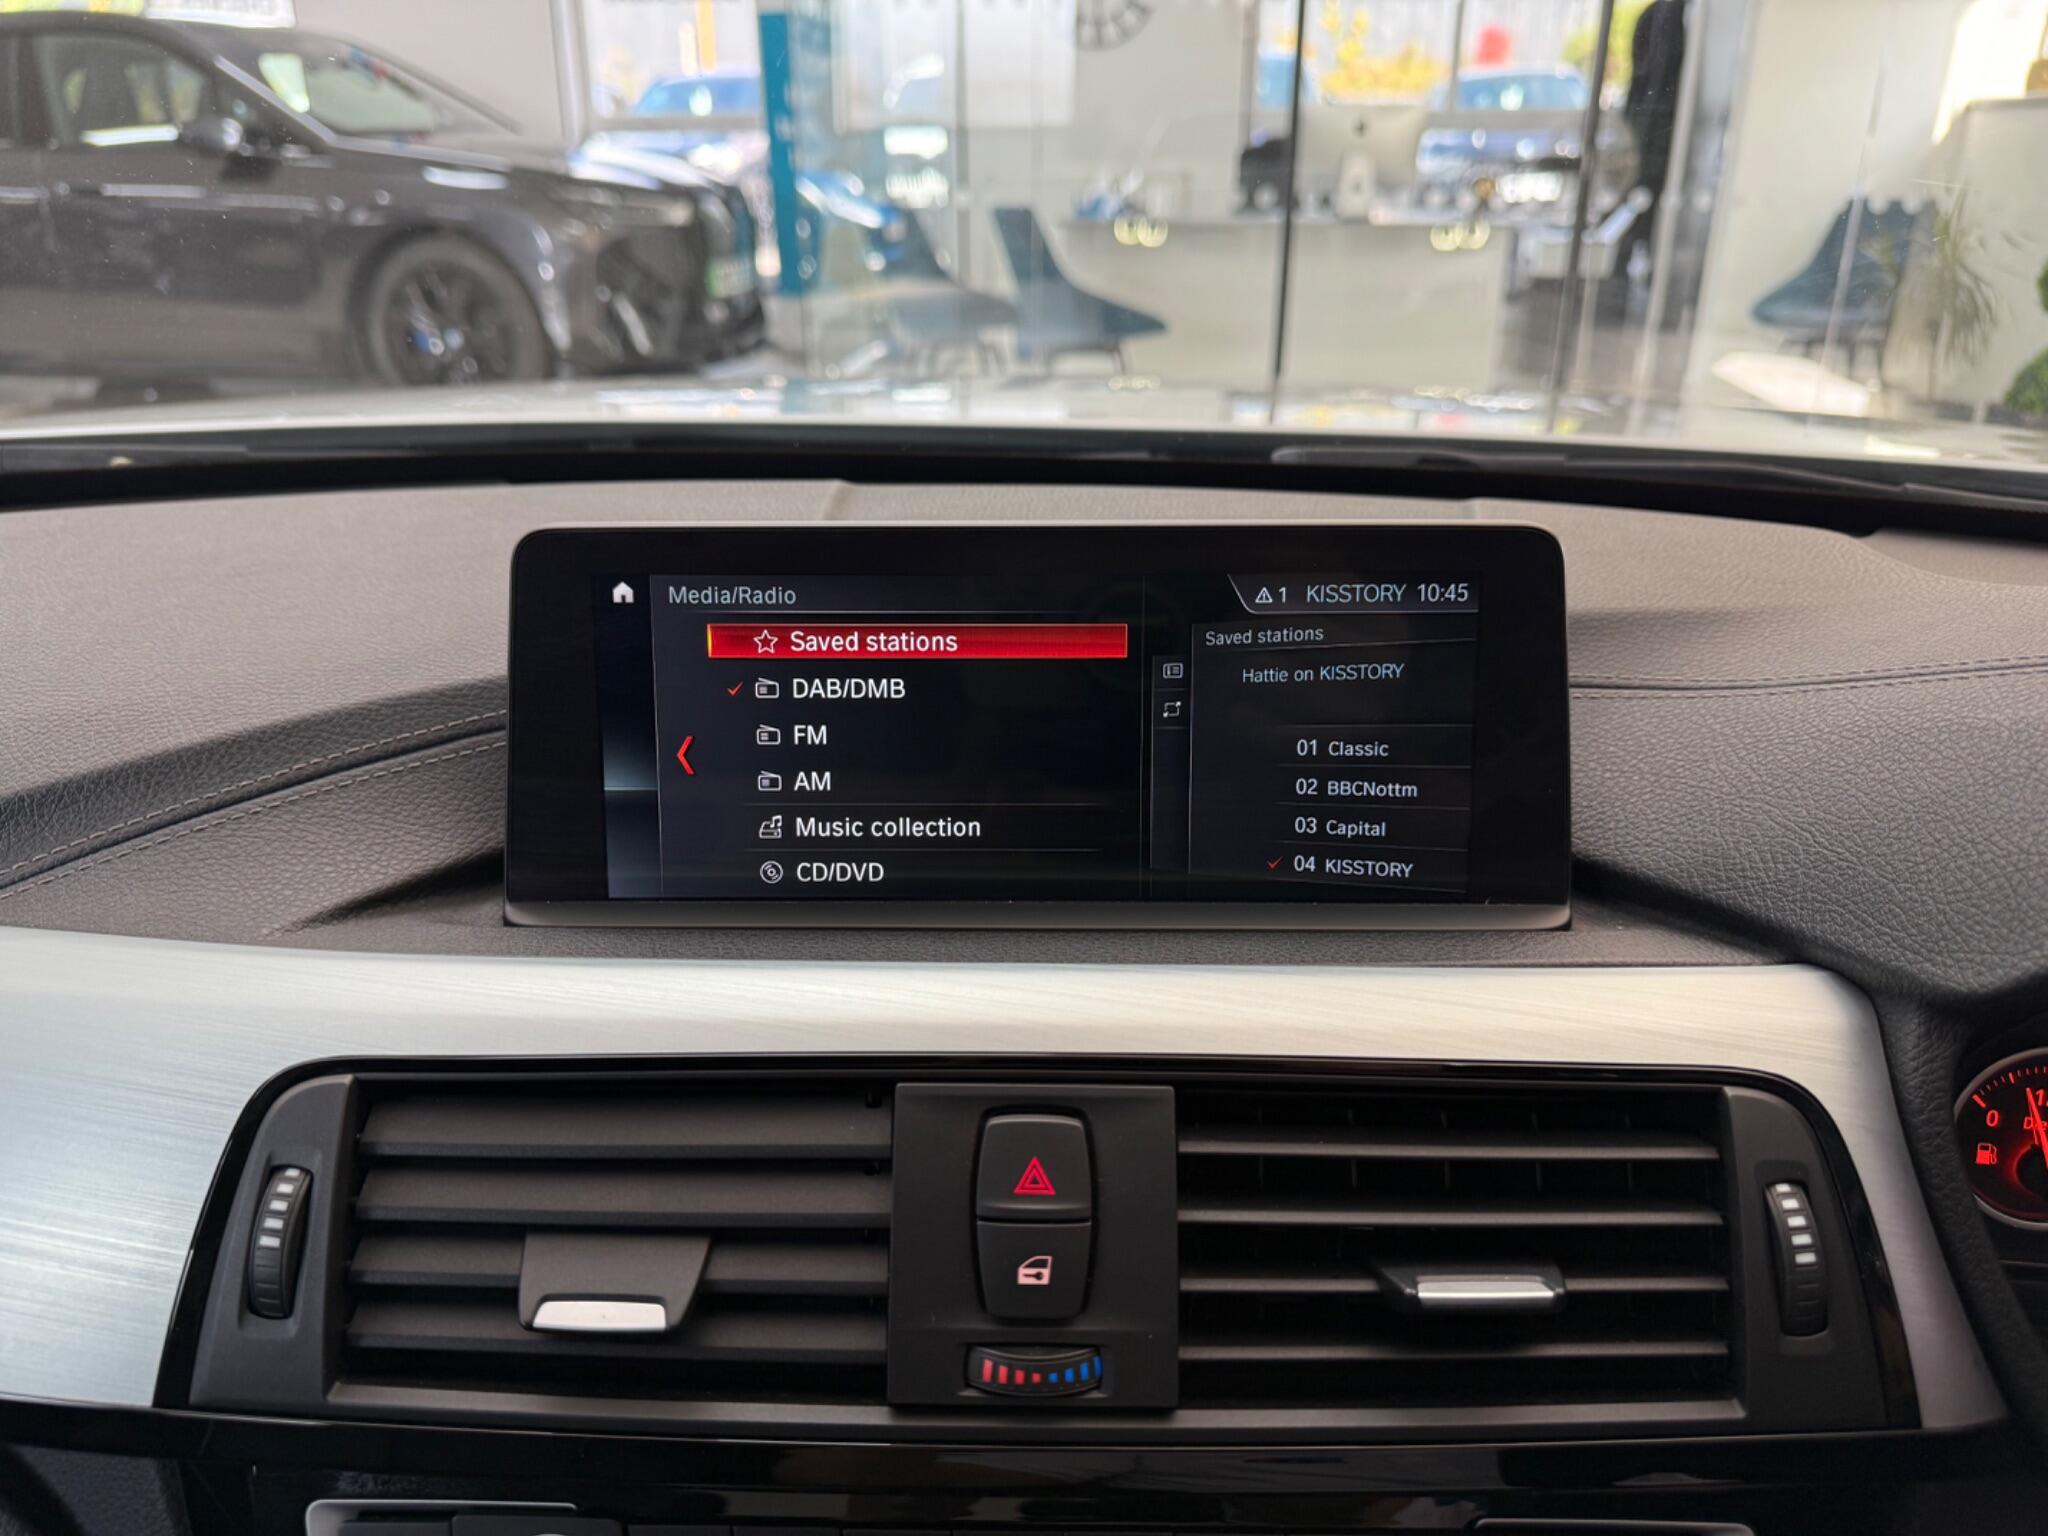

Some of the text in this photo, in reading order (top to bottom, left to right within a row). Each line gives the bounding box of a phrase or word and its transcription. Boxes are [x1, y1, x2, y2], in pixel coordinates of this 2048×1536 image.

[668, 585, 797, 605] Media/Radio
[1278, 583, 1469, 603] 1 KISSTORY 10:45
[790, 630, 958, 652] Saved stations
[1205, 627, 1324, 646] Saved stations
[1242, 663, 1405, 683] Hattie on KISSTORY
[792, 678, 906, 699] DAB/DMB
[793, 724, 828, 745] FM
[1296, 738, 1389, 758] 01 Classic
[793, 771, 832, 791] AM
[1295, 777, 1418, 798] 02 BBCNottm
[795, 816, 981, 838] Music collection
[1294, 816, 1386, 838] 03 Capital
[796, 862, 885, 882] CD/DVD
[1293, 854, 1414, 878] 04 KISSTORY
[1986, 1109, 1999, 1127] 0
